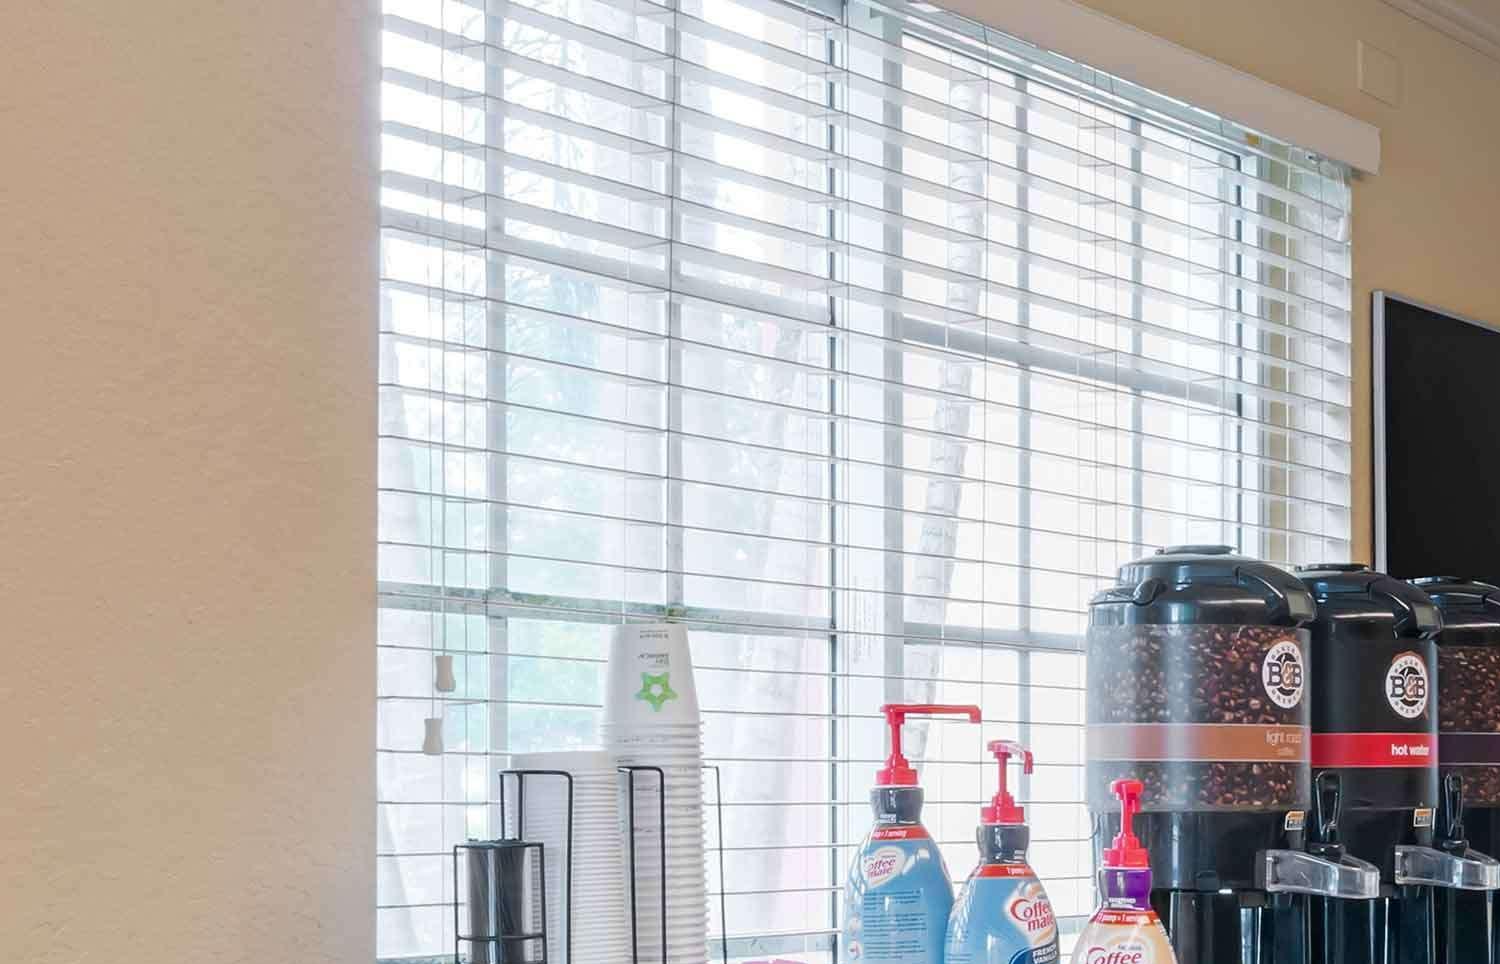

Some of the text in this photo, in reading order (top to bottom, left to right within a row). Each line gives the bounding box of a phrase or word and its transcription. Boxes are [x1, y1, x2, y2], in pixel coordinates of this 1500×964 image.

[1266, 661, 1302, 688] B&B
[1389, 674, 1426, 699] B&B
[1391, 743, 1408, 756] hot
